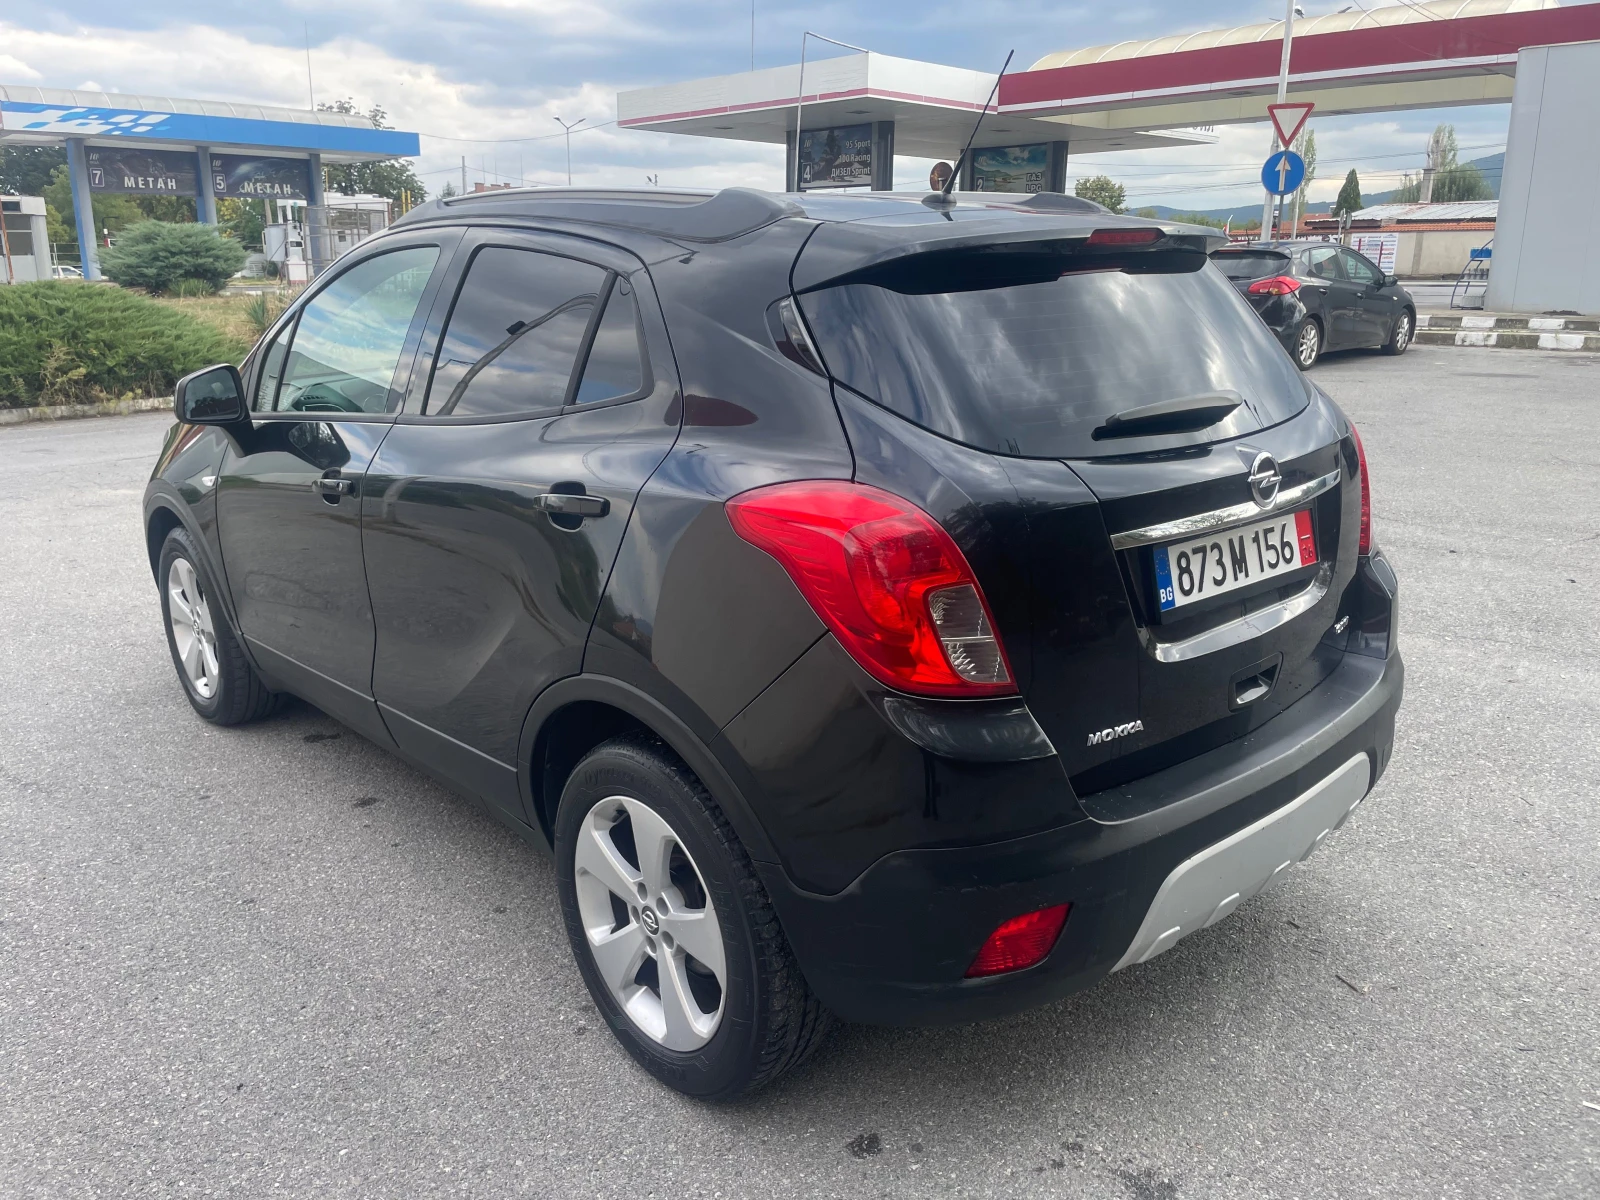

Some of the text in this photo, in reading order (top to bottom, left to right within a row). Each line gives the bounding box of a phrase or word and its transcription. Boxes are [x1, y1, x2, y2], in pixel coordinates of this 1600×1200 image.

[854, 140, 871, 150] Sport
[850, 153, 871, 163] Racing
[92, 170, 102, 184] 7
[803, 165, 811, 181] 4
[830, 166, 871, 178] ДИЗЕЛ Sprint
[1026, 172, 1042, 182] ГАЗ
[124, 176, 177, 190] МЕТАН
[215, 176, 225, 190] 5
[244, 182, 291, 195] МЕТАН
[977, 178, 983, 192] 2
[1026, 184, 1042, 193] LPG
[1176, 522, 1295, 597] 873 M 156
[1159, 586, 1173, 603] BG
[1086, 719, 1145, 747] MOKKA
